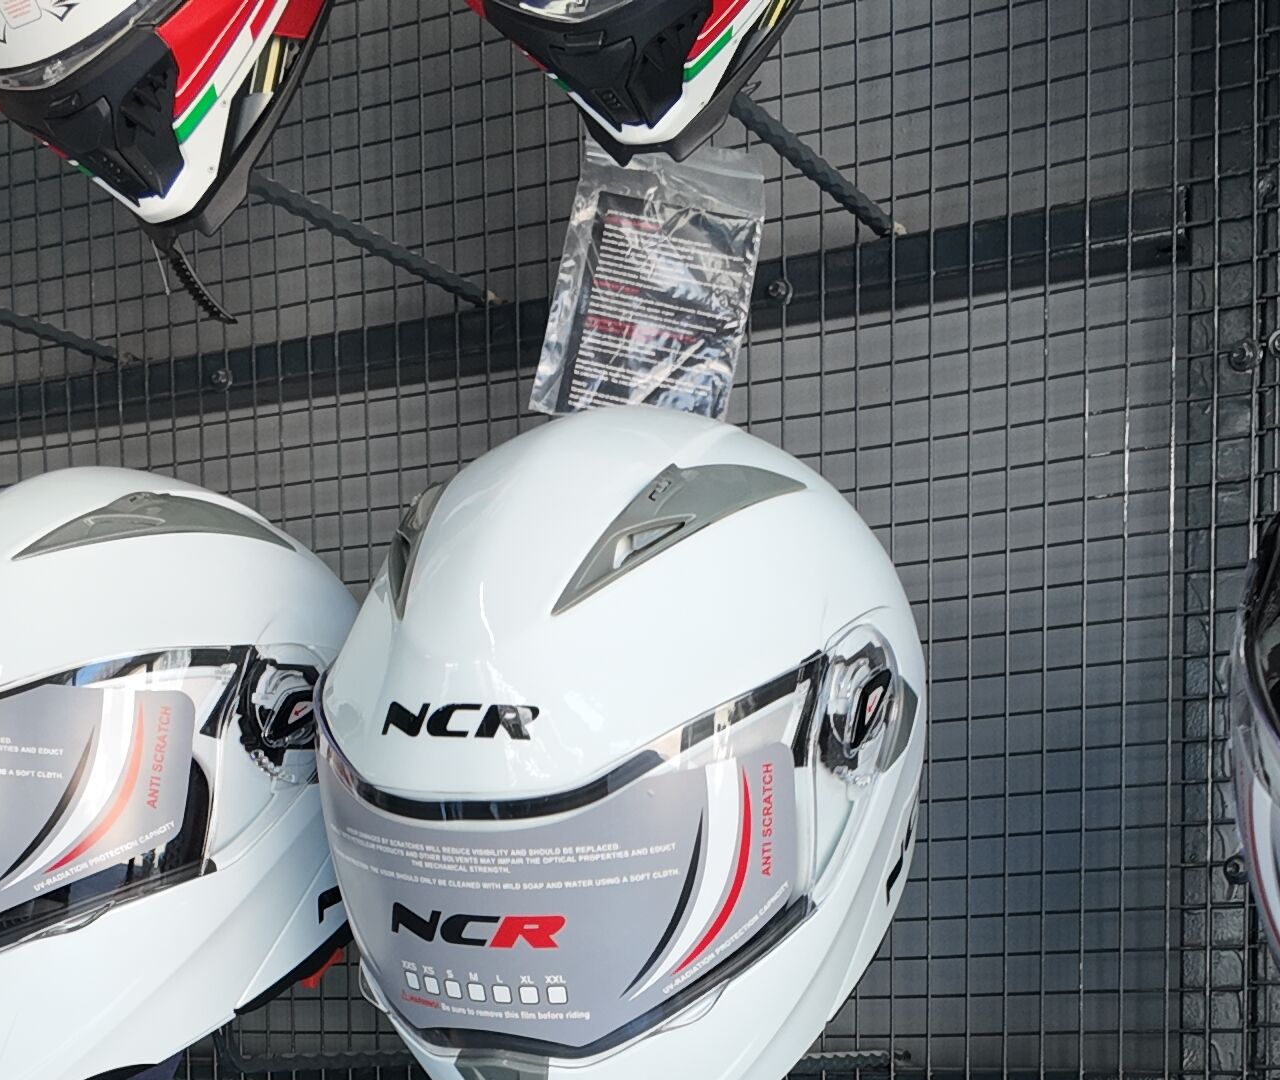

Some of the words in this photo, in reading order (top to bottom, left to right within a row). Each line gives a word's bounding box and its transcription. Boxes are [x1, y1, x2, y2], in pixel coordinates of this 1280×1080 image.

[382, 701, 540, 740] NCR
[146, 775, 160, 808] ANTI
[153, 706, 172, 772] SCRATCH
[762, 763, 773, 839] SCRATCH
[89, 839, 138, 866] PROTECTION
[761, 843, 773, 876] ANTI
[391, 903, 566, 949] NCR
[422, 965, 435, 975] XS
[446, 969, 454, 979] S
[469, 972, 479, 982] M
[496, 975, 503, 983] L
[521, 975, 534, 983] XL
[545, 975, 566, 983] XXL
